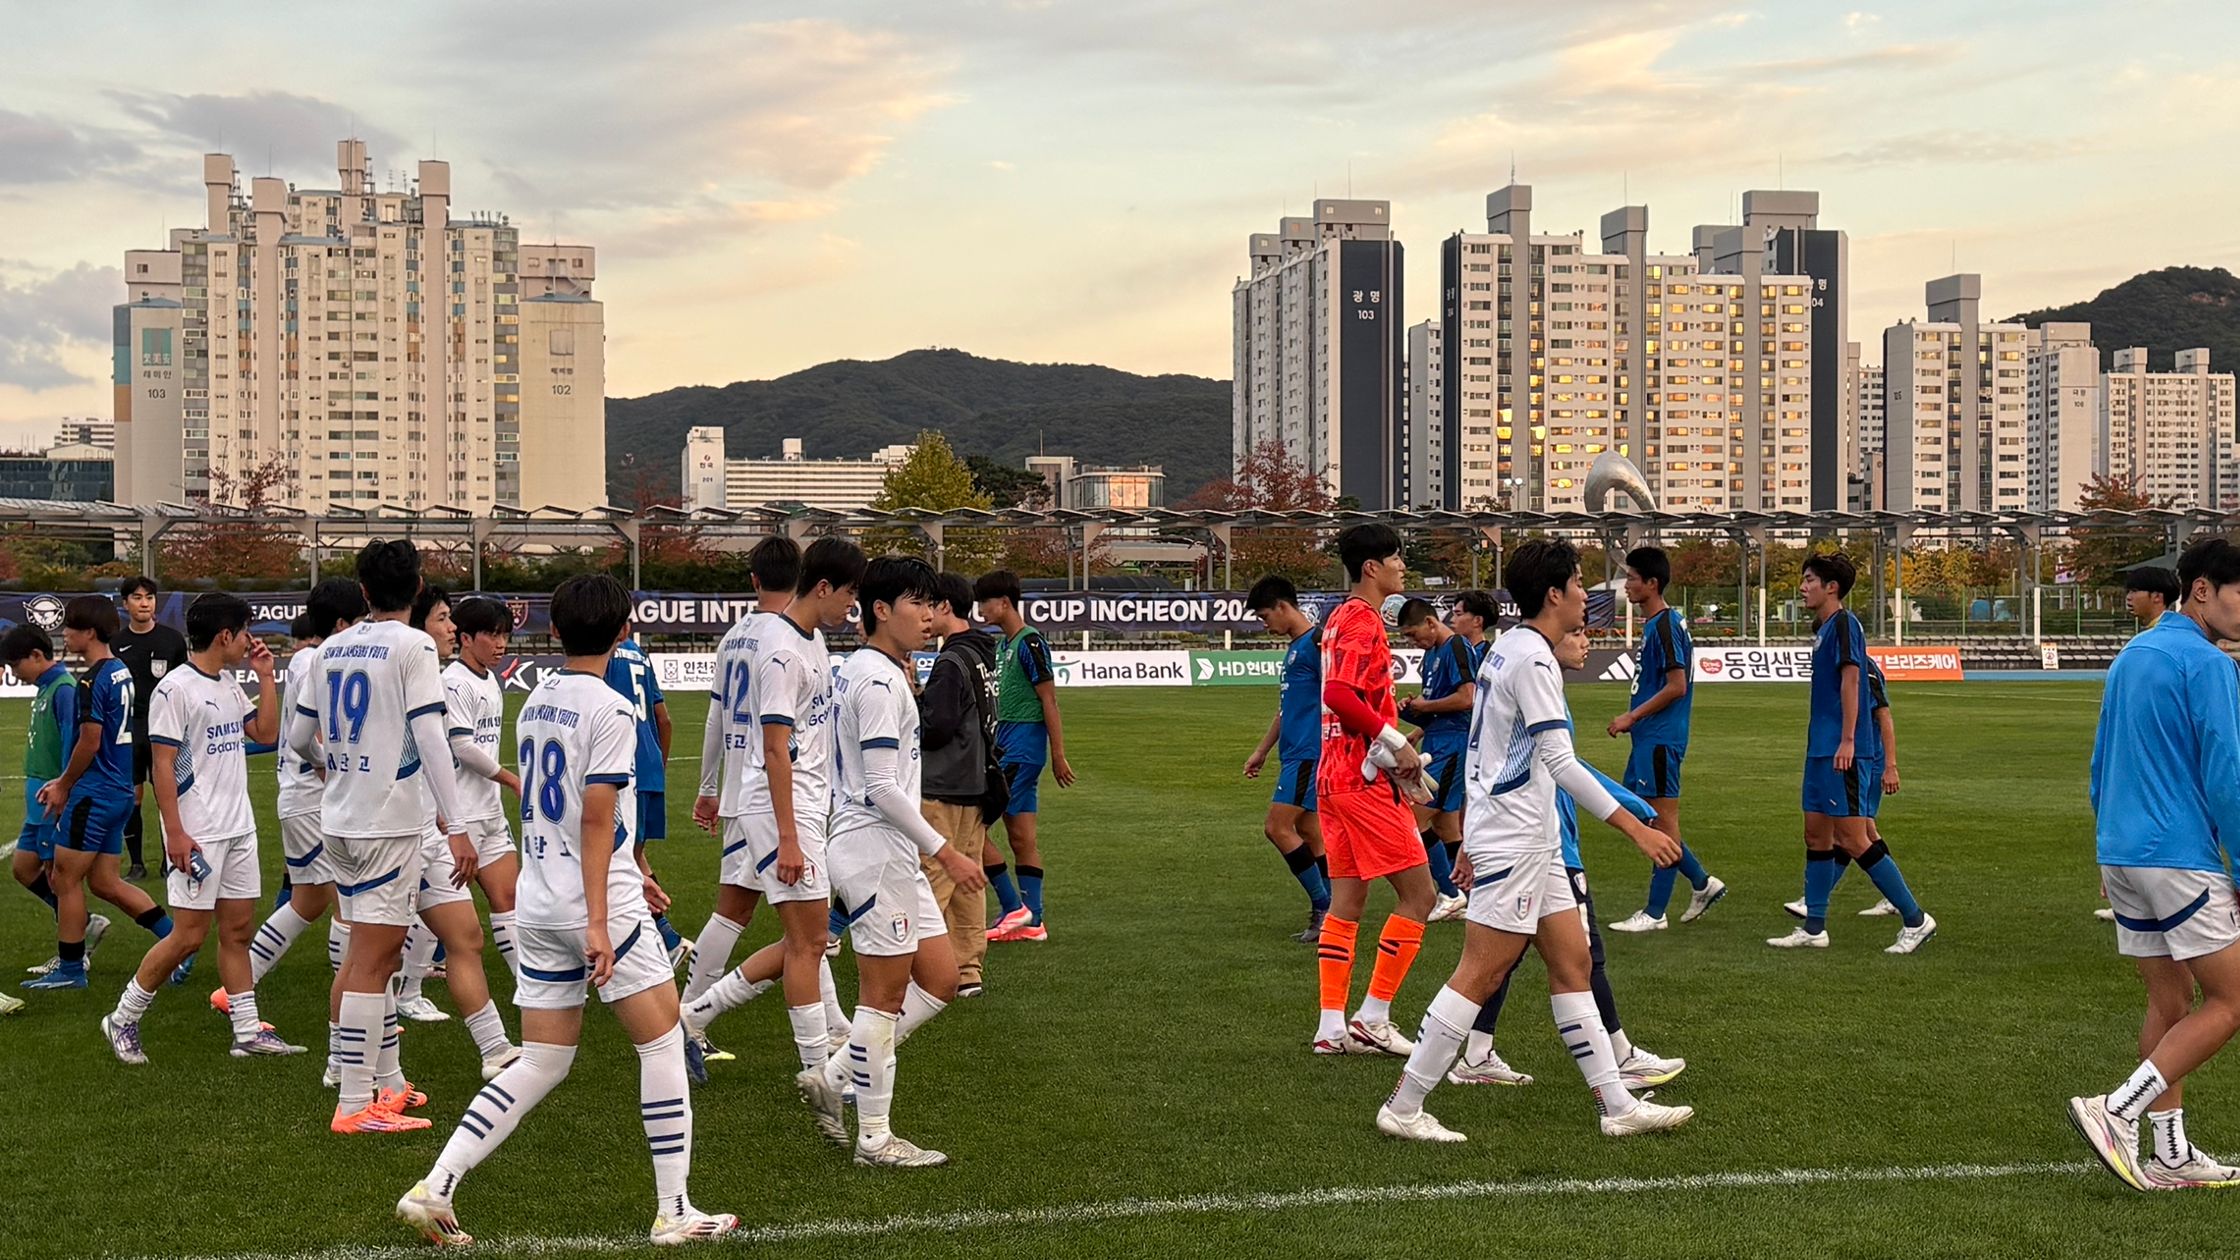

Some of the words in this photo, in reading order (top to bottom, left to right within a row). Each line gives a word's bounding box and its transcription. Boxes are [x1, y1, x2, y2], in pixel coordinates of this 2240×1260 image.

[1357, 310, 1375, 320] 103
[147, 388, 166, 399] 103
[551, 384, 571, 395] 102
[1029, 599, 1085, 622] CUP
[1090, 600, 1208, 622] INCHEON
[1213, 599, 1264, 621] 202
[1081, 662, 1132, 680] Hana
[1136, 661, 1184, 679] Bank
[1724, 651, 1813, 679] 동원샘물
[1884, 654, 1958, 670] 브리즈케어
[629, 663, 647, 722] 5
[326, 669, 372, 745] 19
[519, 736, 566, 825] 28
